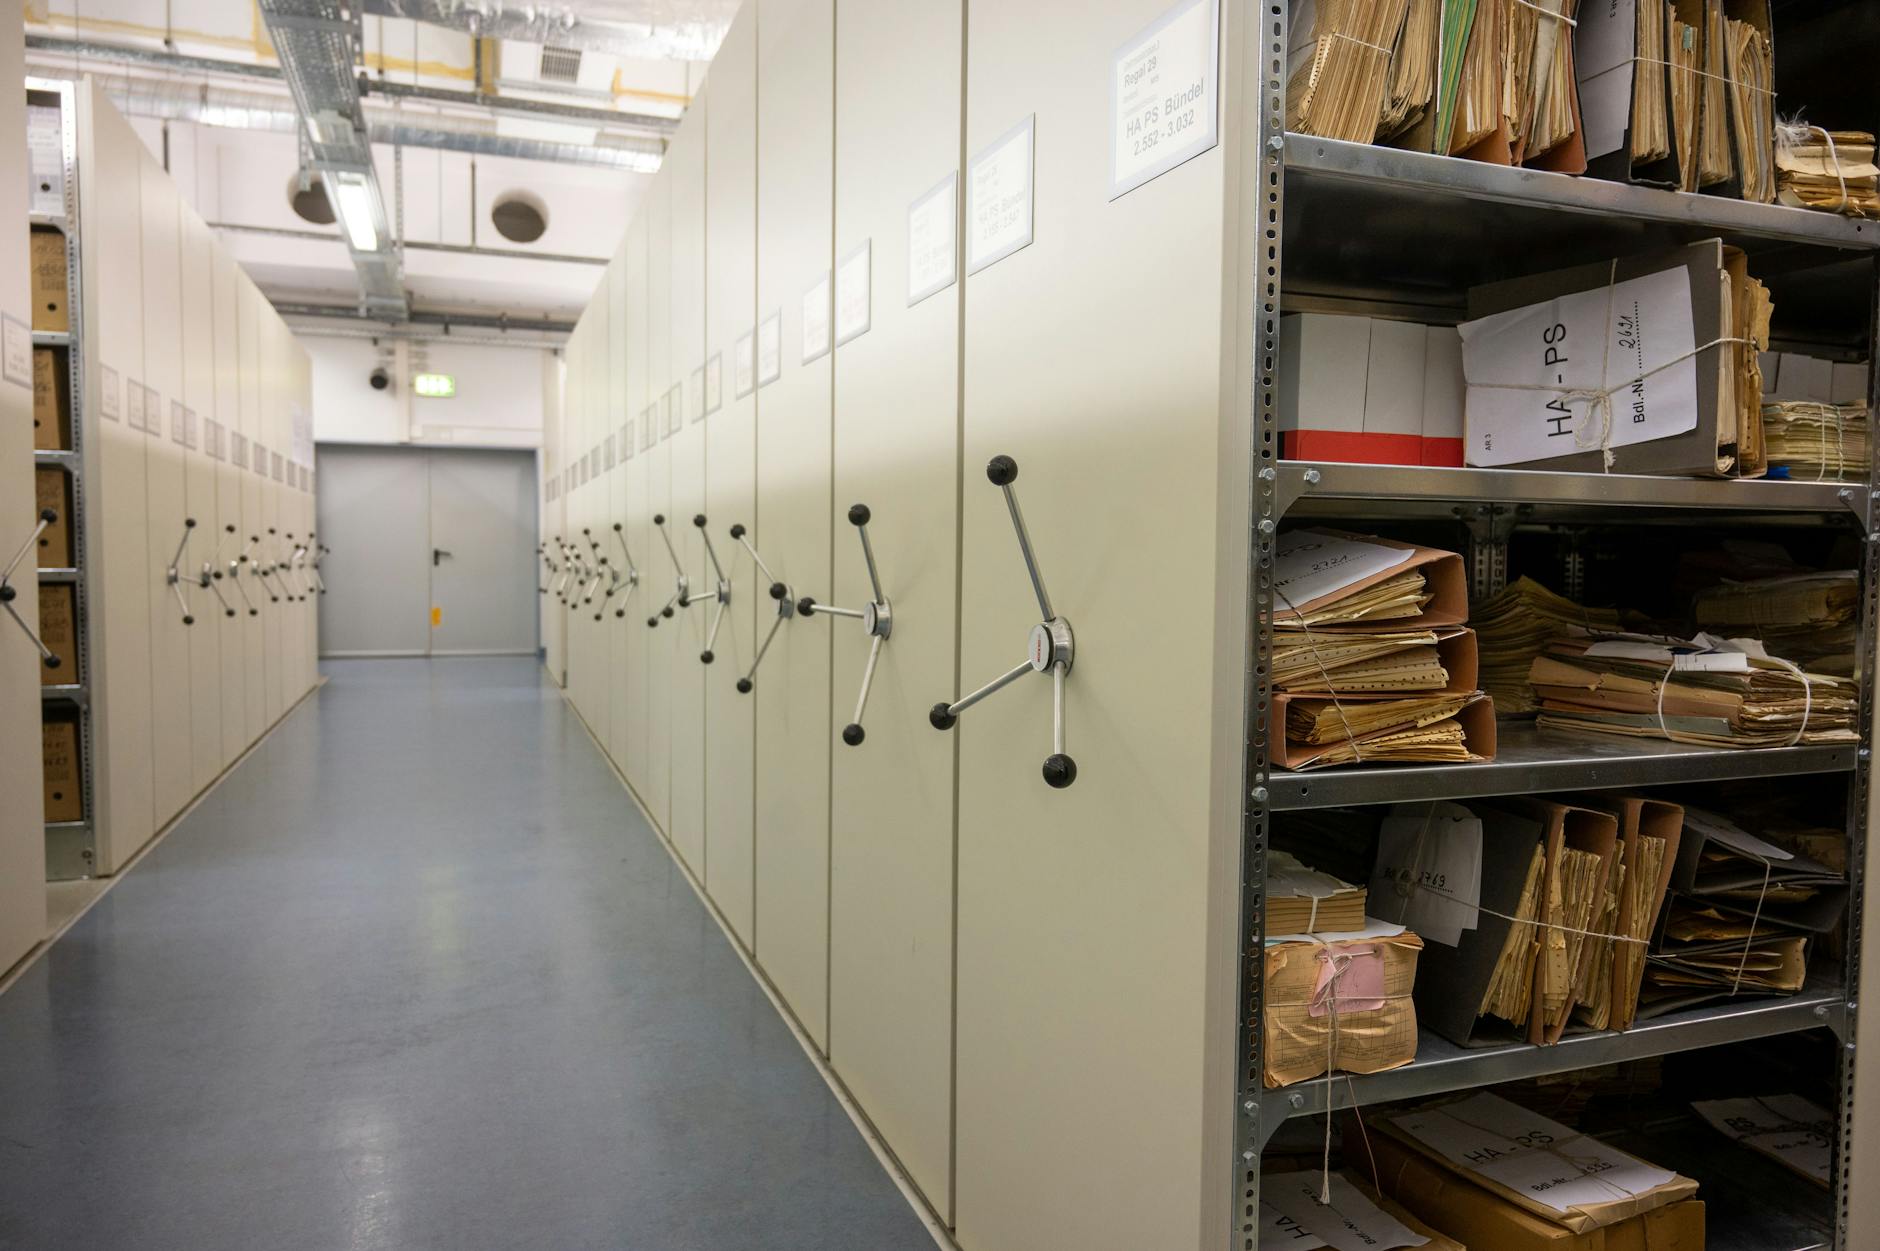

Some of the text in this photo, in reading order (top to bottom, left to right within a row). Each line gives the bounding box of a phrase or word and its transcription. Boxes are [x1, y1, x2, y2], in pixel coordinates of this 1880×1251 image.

[1124, 63, 1147, 88] Regal
[1147, 56, 1157, 73] 29
[1126, 118, 1142, 138] HA
[1144, 106, 1159, 128] PS
[1164, 77, 1205, 116] Bündel
[1134, 129, 1159, 156] 2.552
[1167, 109, 1195, 138] 3.032
[1543, 323, 1569, 366] PS
[1546, 399, 1573, 437] HA
[1484, 440, 1492, 450] AR
[1464, 1146, 1502, 1165] HA
[1515, 1130, 1554, 1149] PS
[1275, 1215, 1313, 1239] HA
